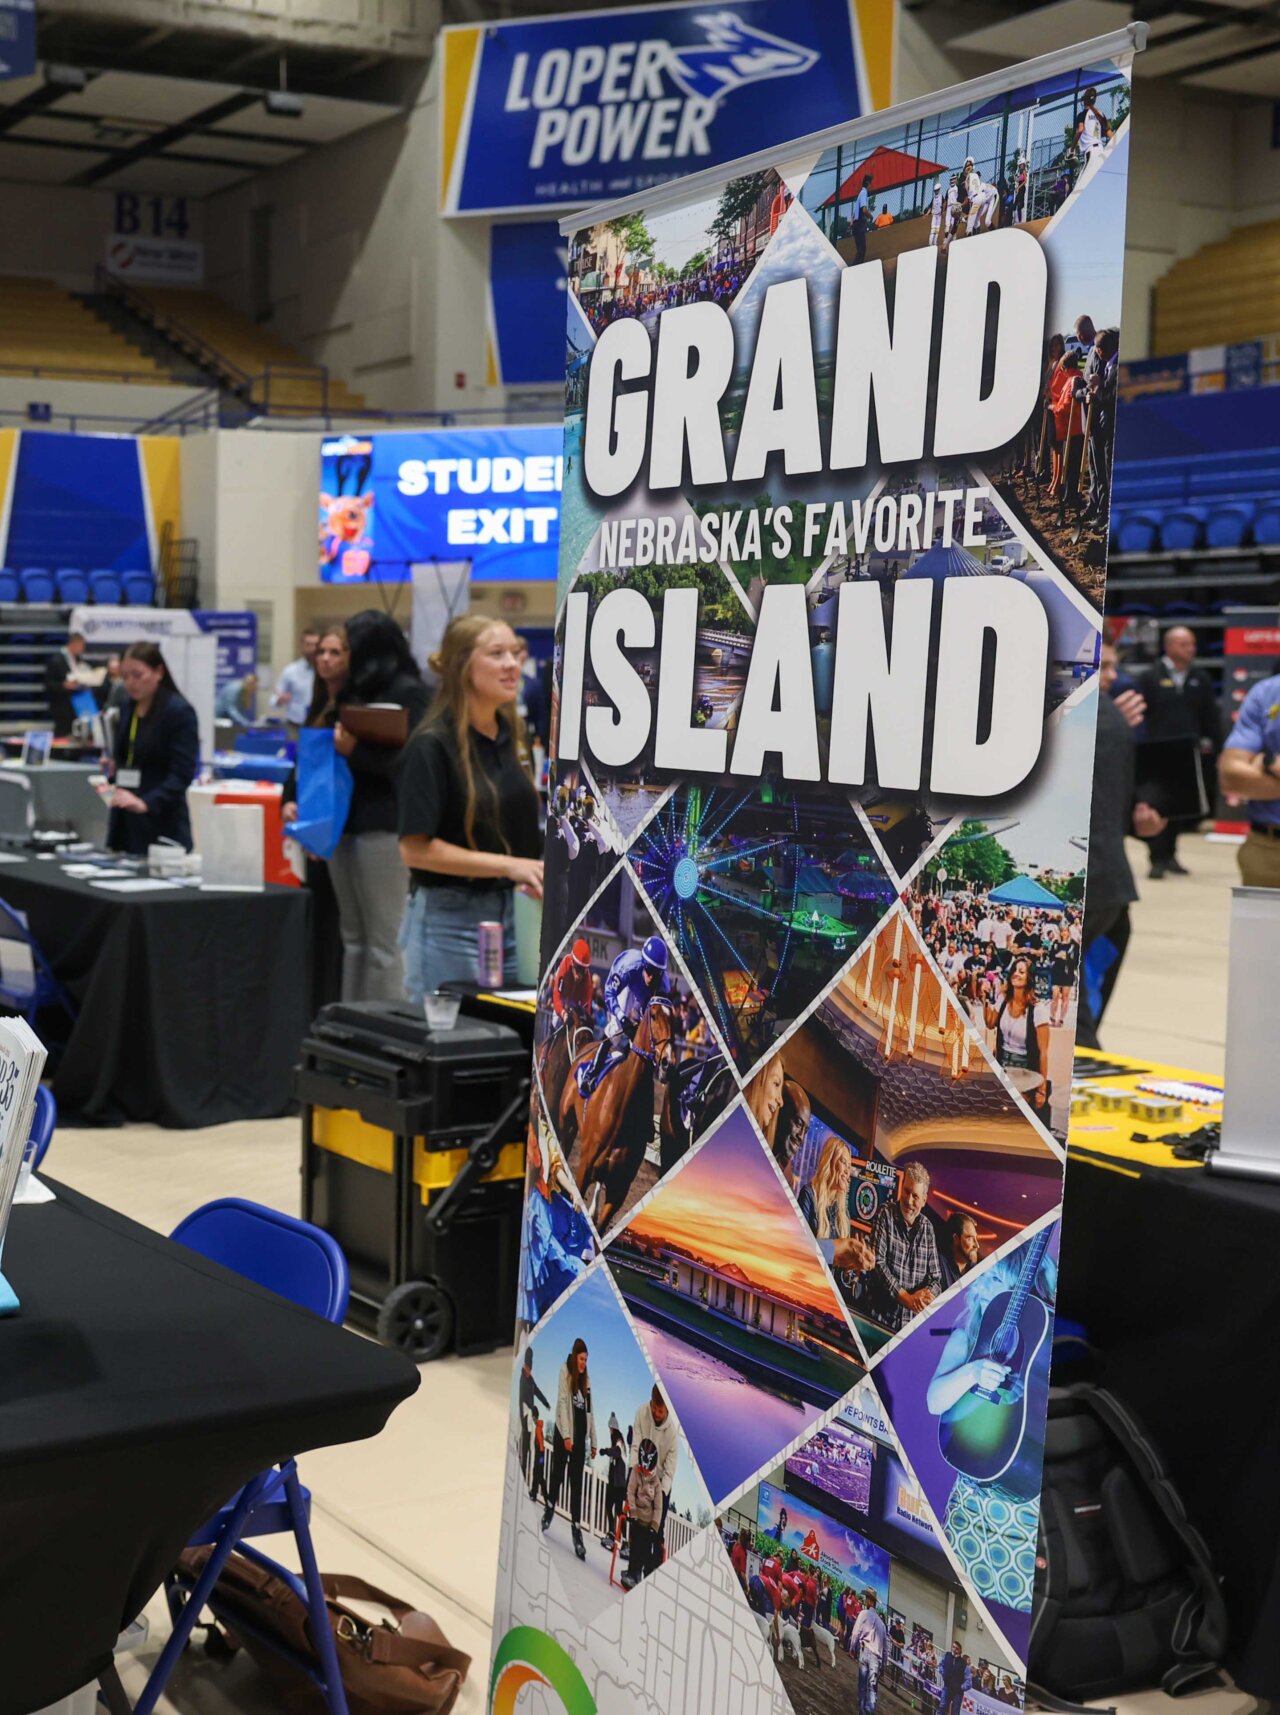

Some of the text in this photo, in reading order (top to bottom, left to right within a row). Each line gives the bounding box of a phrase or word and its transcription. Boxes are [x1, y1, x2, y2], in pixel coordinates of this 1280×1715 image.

[505, 39, 671, 112] LOPER
[528, 97, 716, 169] POWER
[115, 191, 190, 239] B14
[583, 227, 1048, 497] GRAND
[397, 455, 563, 496] STUDE
[447, 507, 558, 545] EXIT
[598, 486, 990, 568] NEBRASKA'S FAVORITE
[558, 575, 1050, 797] ISLAND
[866, 1160, 897, 1178] ROULETTE
[897, 1506, 911, 1521] Radio
